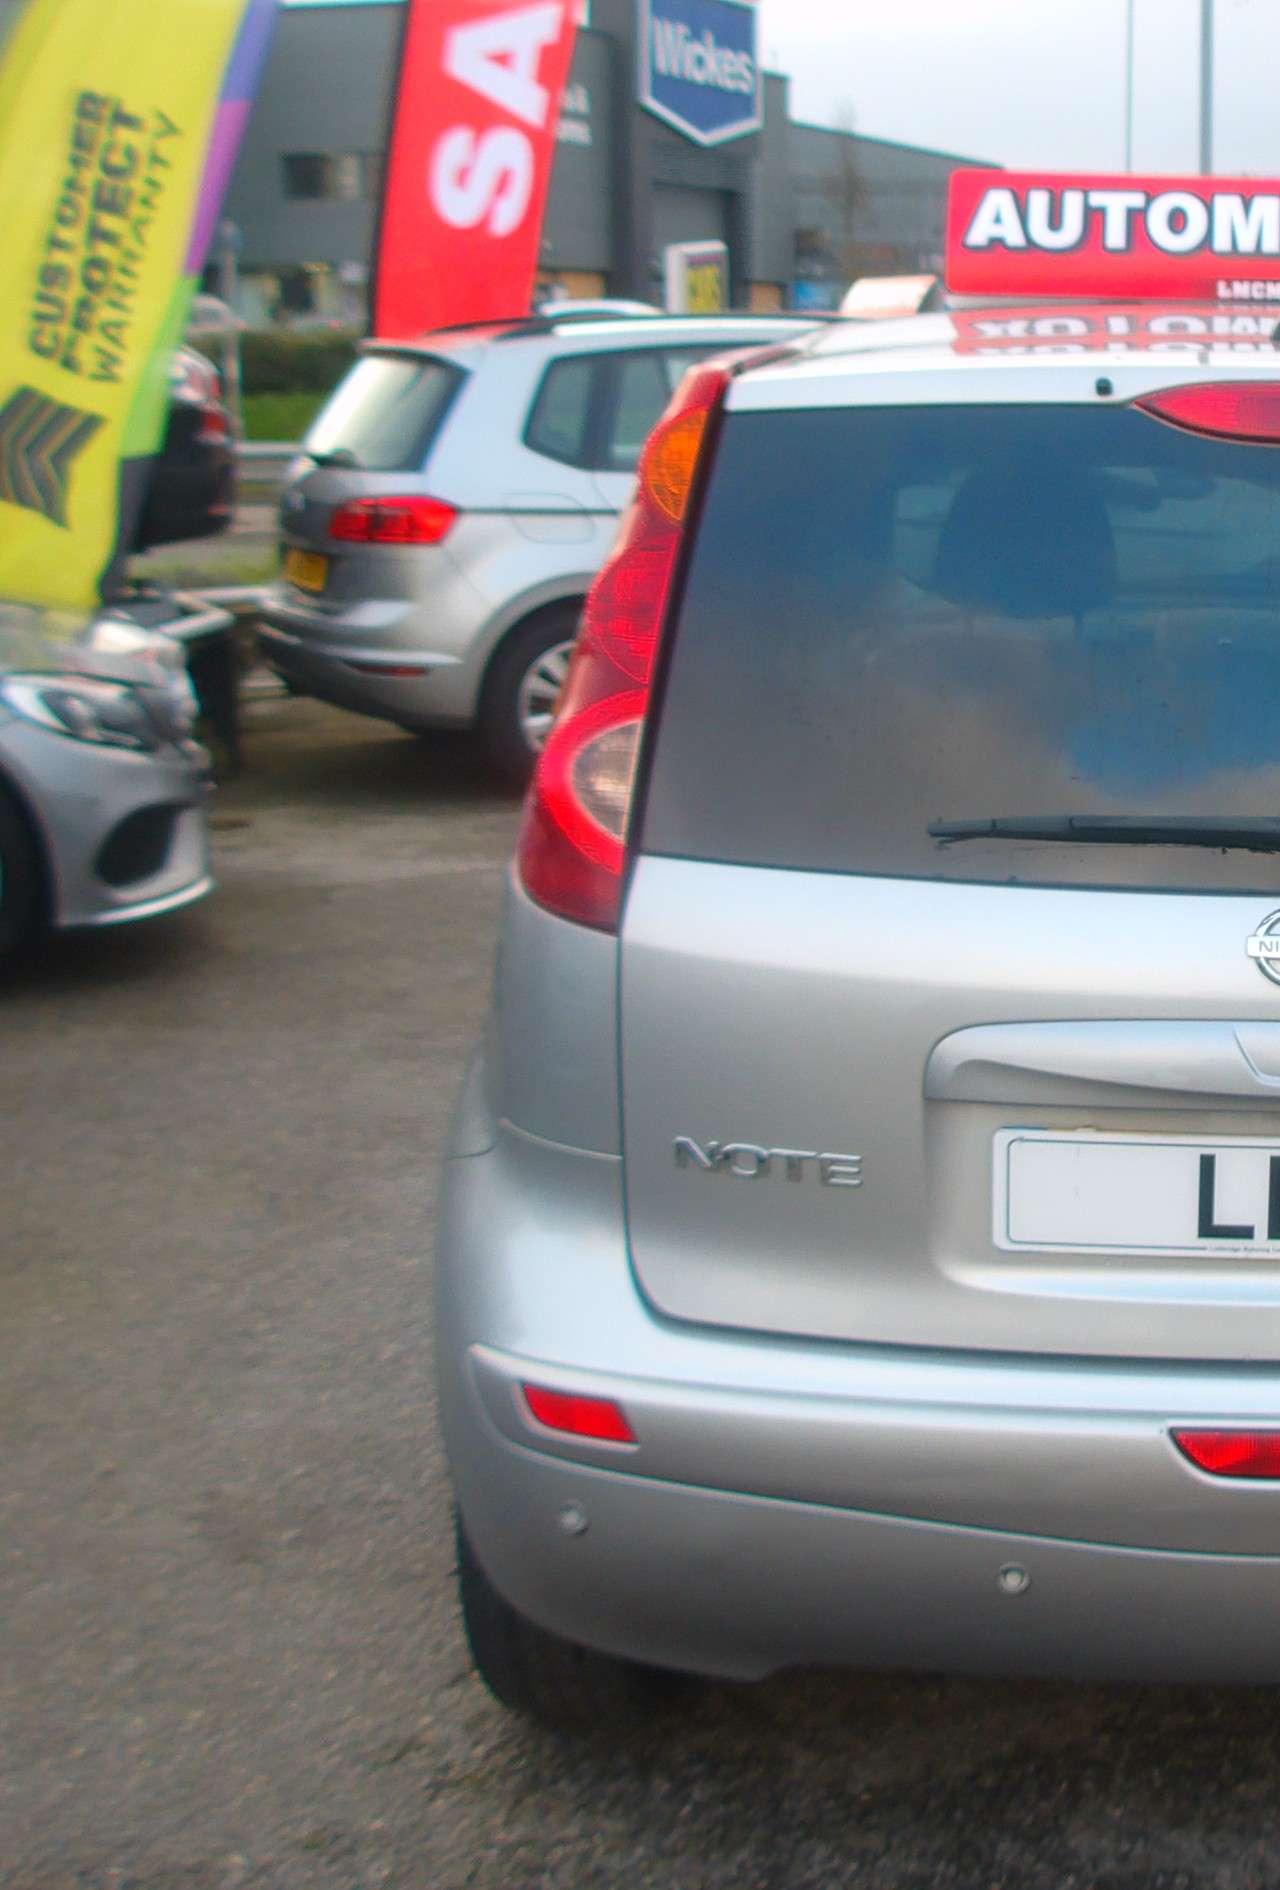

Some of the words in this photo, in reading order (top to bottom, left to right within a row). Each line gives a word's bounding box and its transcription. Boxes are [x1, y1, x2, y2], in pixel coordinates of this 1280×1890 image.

[652, 17, 752, 94] Wickes
[28, 89, 107, 360] CUSTOMER
[59, 97, 147, 376] PROTECT
[87, 108, 182, 384] WARRANTY
[674, 1135, 863, 1187] NOTE
